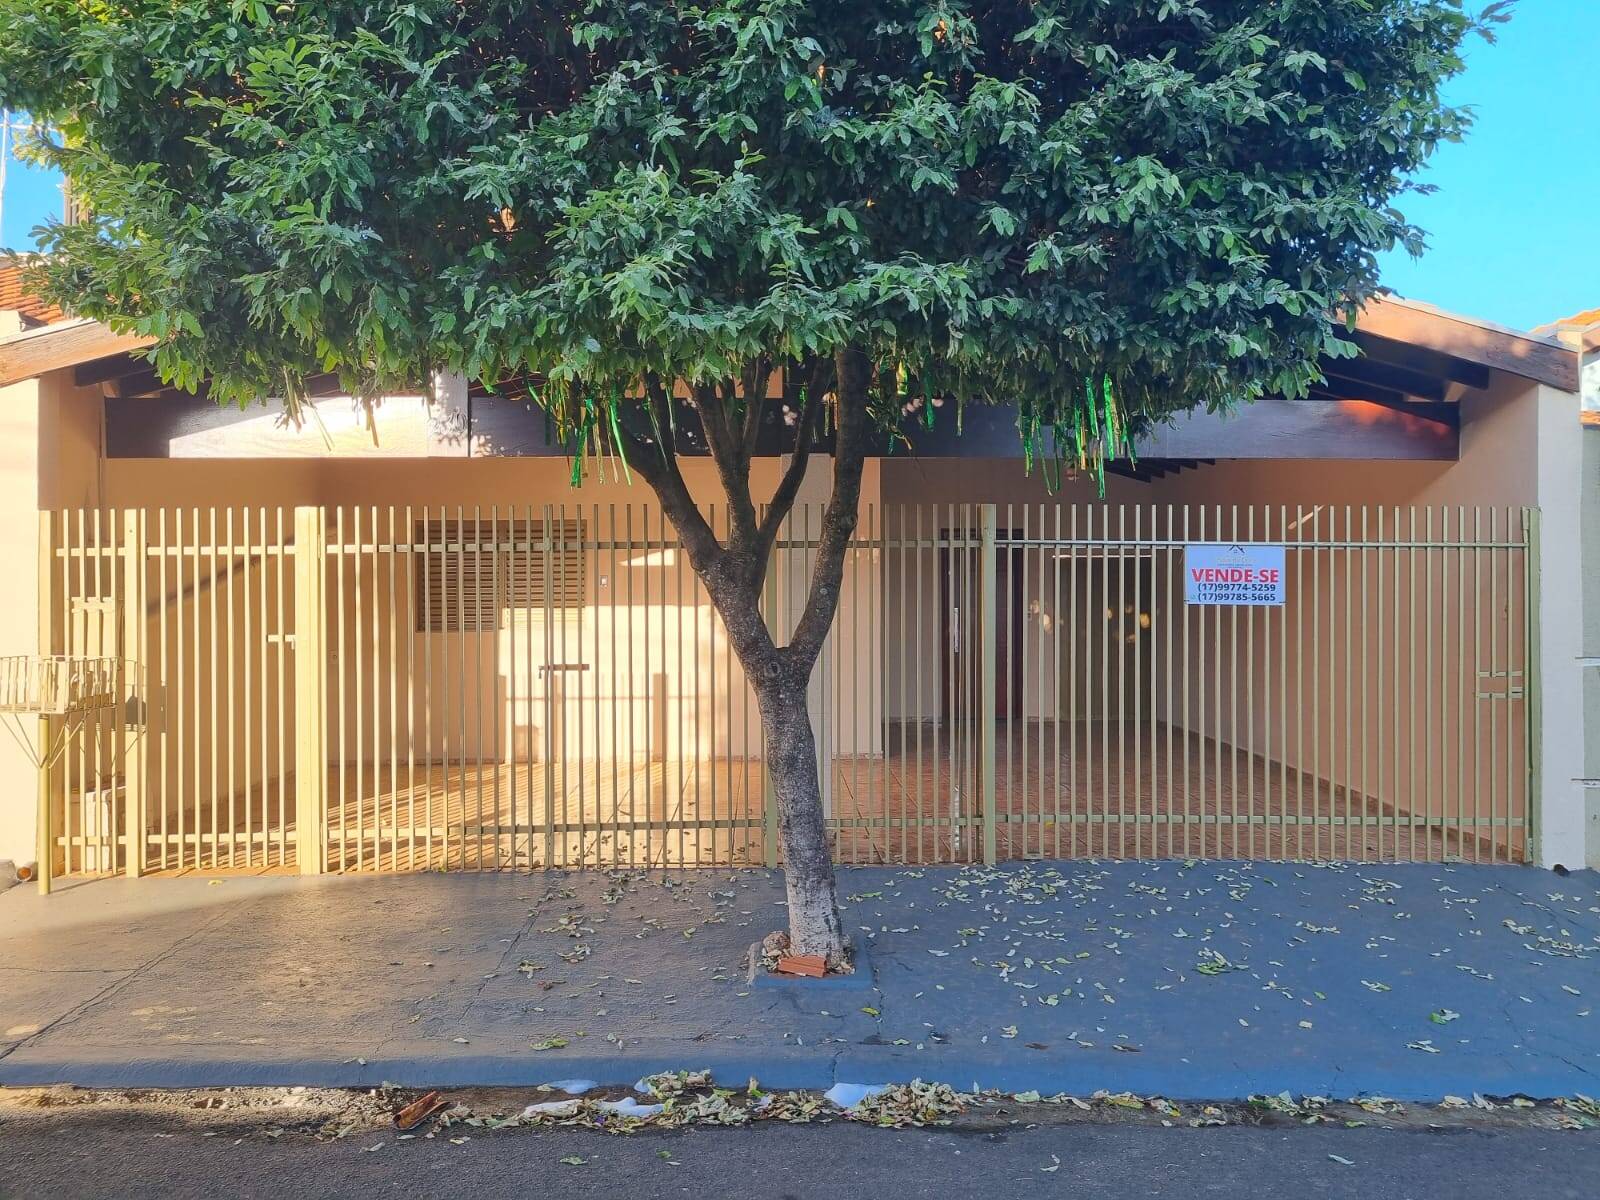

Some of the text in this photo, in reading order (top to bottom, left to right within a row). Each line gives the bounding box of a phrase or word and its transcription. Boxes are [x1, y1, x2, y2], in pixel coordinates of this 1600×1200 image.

[1191, 569, 1279, 583] VENDE-SE
[1198, 583, 1276, 592] (17)99774-5259
[1198, 593, 1276, 602] (17)99785-5665
